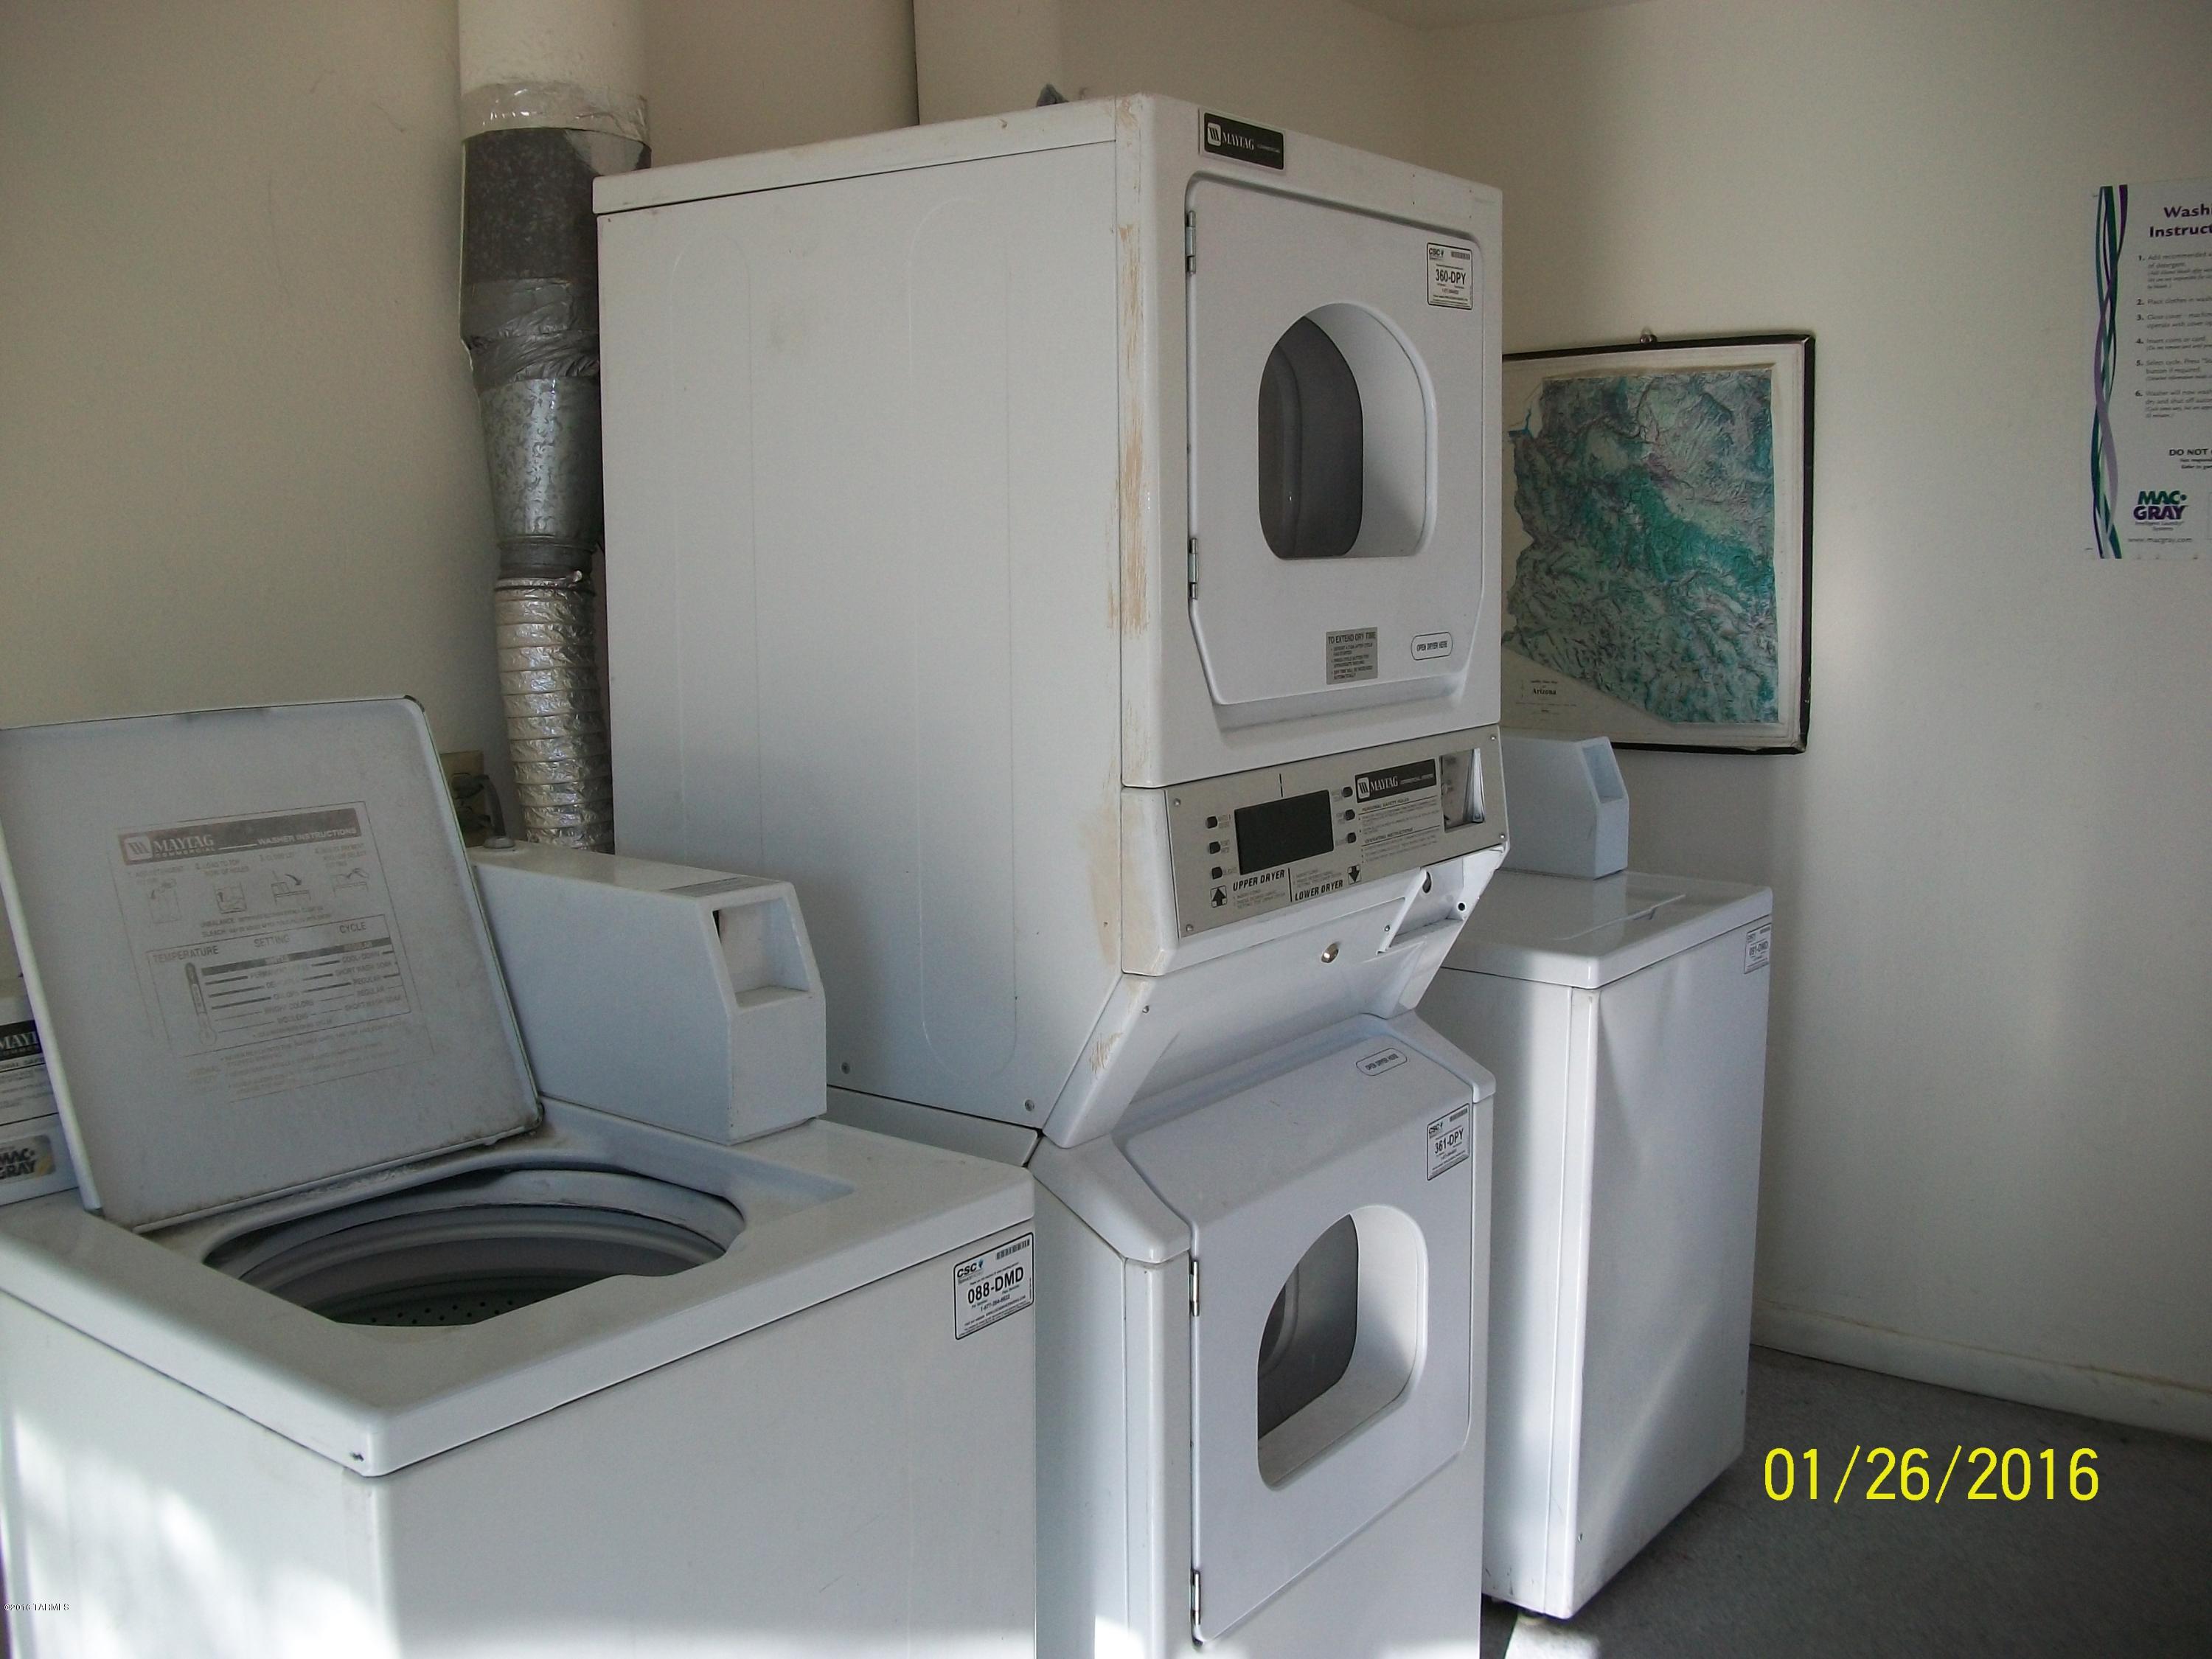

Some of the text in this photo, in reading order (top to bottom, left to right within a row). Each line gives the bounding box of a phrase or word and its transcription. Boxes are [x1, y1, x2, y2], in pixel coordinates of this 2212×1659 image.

[1222, 131, 1254, 150] MAYTAG
[1435, 268, 1467, 285] 360-DPY
[2169, 448, 2209, 456] DO NOT
[2133, 505, 2188, 521] GRAY
[1370, 776, 1399, 792] MAYTAG
[153, 834, 215, 853] MAYTAG
[257, 827, 357, 846] WASHER INSTRUCTIONS
[1233, 877, 1258, 891] UPPER
[1260, 869, 1285, 884] DRYER
[1295, 887, 1319, 901] LOWER
[1321, 880, 1343, 894] DRYER
[153, 921, 366, 964] TEMPERATURE SETTING CYCLE
[1434, 1127, 1464, 1155] 361-DPY
[957, 1262, 978, 1279] CSC
[967, 1266, 1024, 1304] 088-DMD
